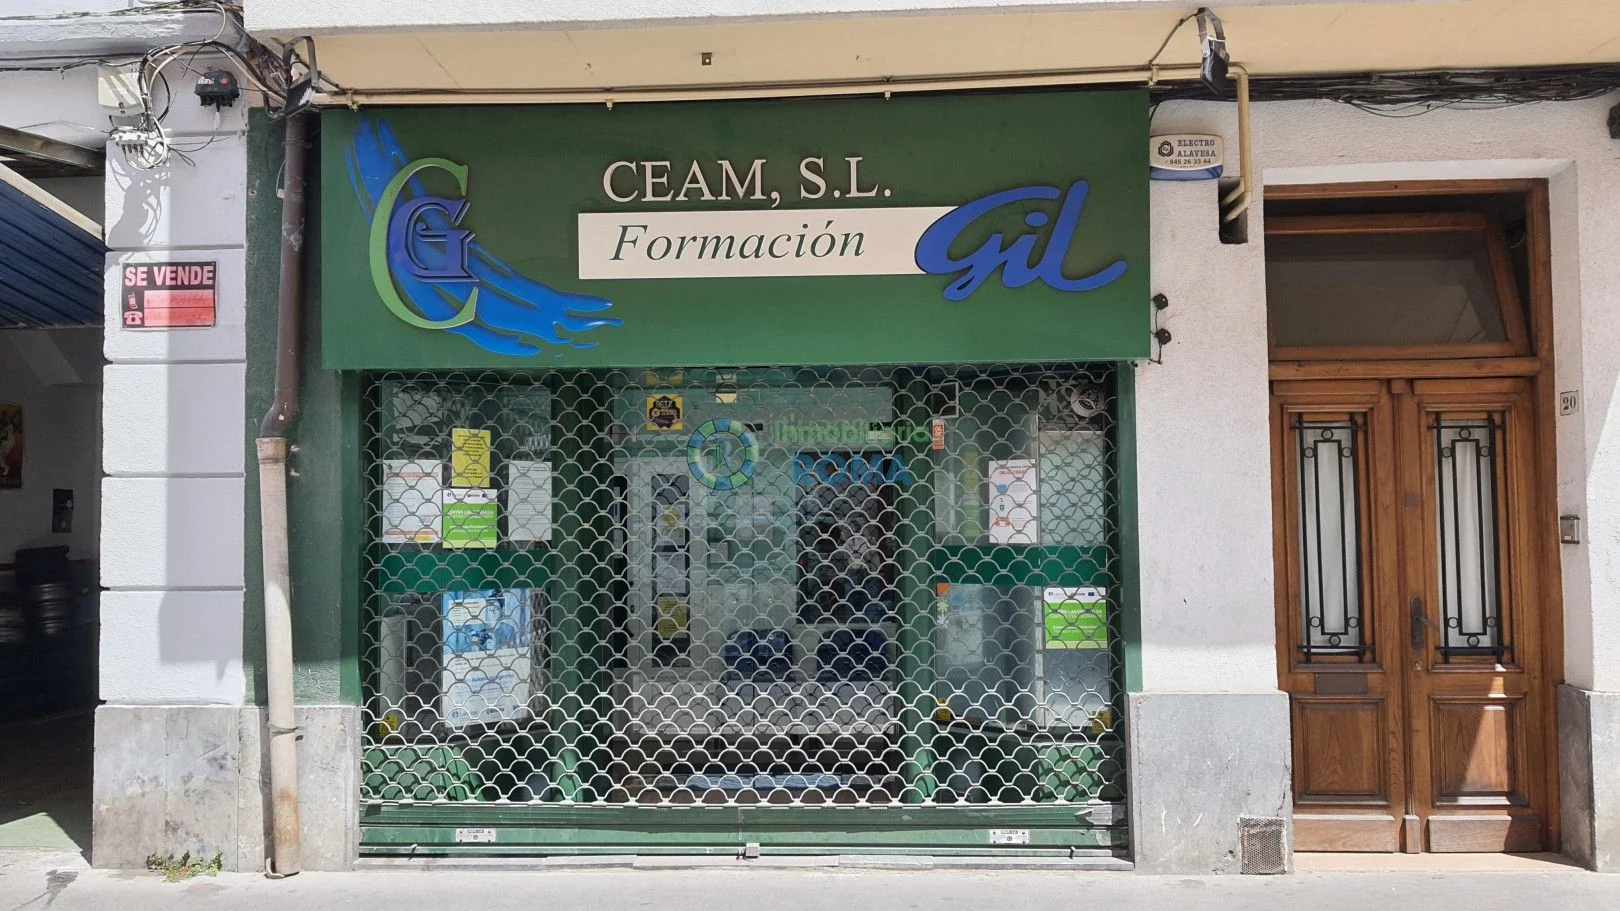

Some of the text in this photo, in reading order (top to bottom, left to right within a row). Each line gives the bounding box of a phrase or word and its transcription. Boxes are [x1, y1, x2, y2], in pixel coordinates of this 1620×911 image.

[1177, 149, 1217, 157] ALAVESA
[602, 156, 892, 208] CEAM, S.L.
[608, 220, 866, 261] Formación
[914, 180, 1128, 301] Gil
[124, 265, 214, 286] SE VENDE
[1562, 395, 1577, 411] 20
